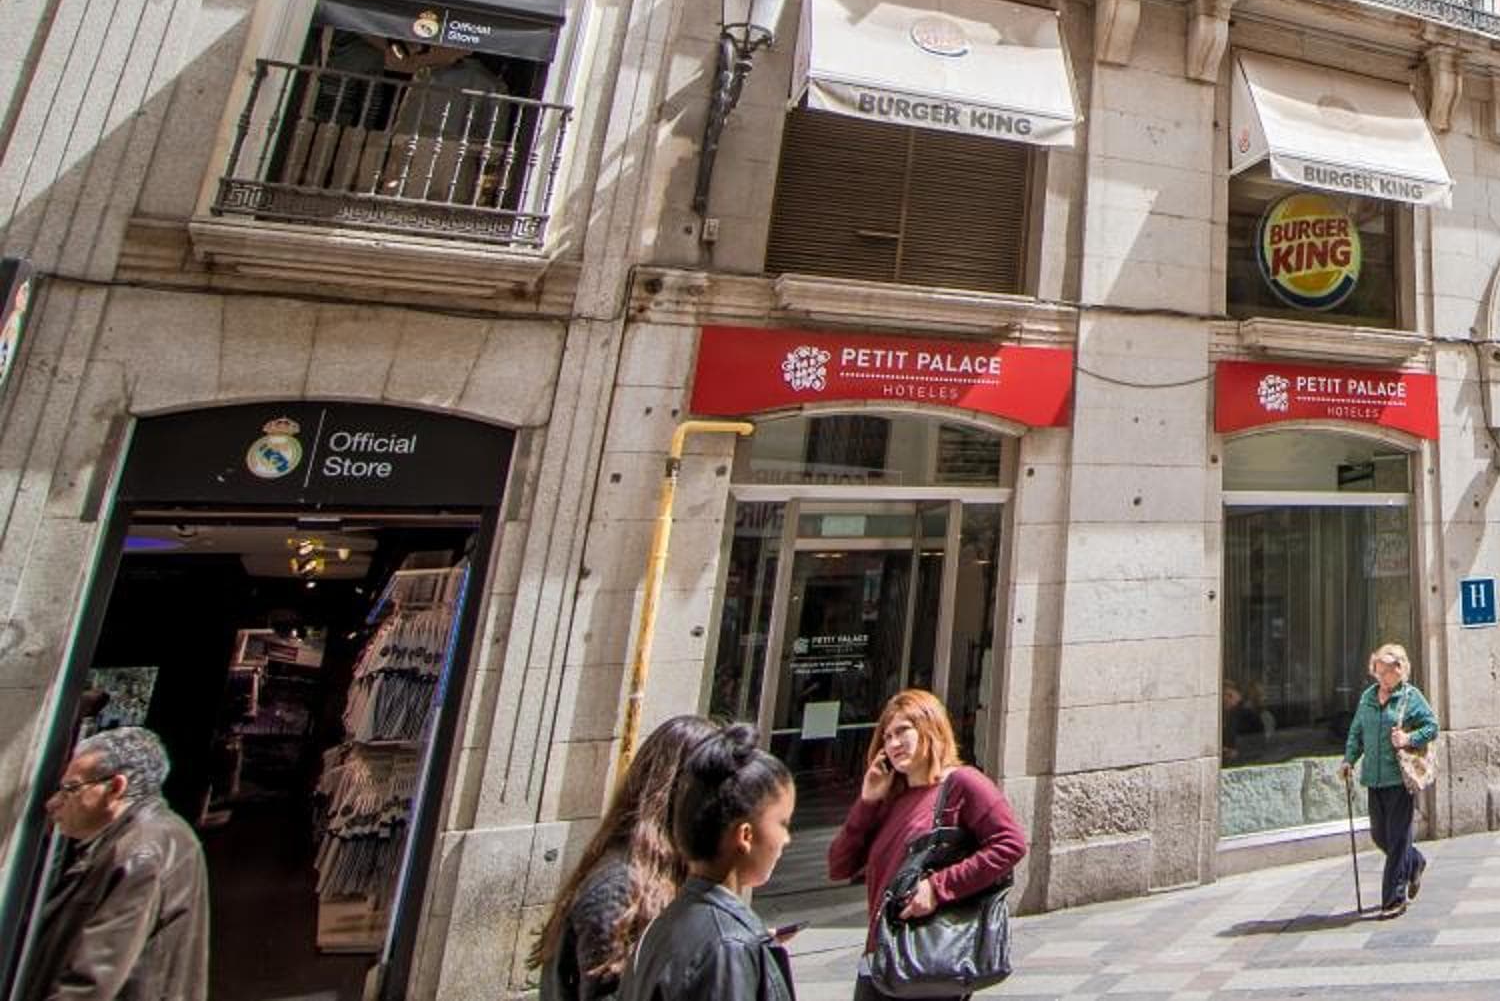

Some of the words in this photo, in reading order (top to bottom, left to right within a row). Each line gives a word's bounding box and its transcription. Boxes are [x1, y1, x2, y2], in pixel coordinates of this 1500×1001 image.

[857, 92, 960, 126] BURGER
[969, 109, 1032, 136] KING
[1303, 165, 1376, 192] BURGER
[1379, 178, 1424, 200] KING
[1269, 218, 1350, 247] BURGER
[1269, 240, 1352, 279] KING
[840, 348, 909, 370] PETIT
[916, 352, 1003, 375] PALACE
[883, 385, 959, 399] HOTELES
[1296, 376, 1342, 394] PETIT
[1347, 379, 1408, 398] PALACE
[1327, 406, 1380, 419] HOTELES
[328, 431, 418, 455] Official
[322, 455, 393, 478] Store
